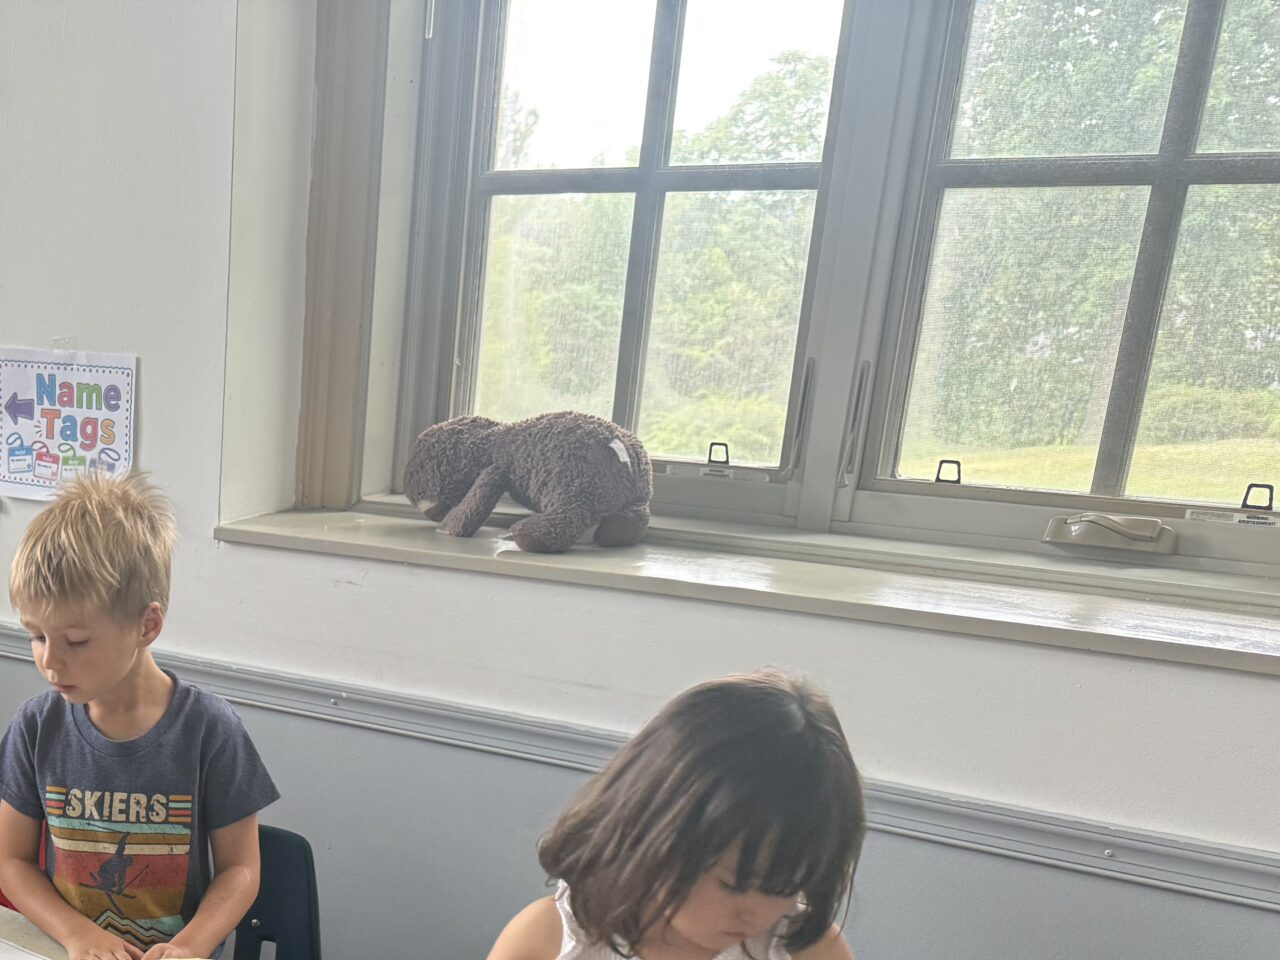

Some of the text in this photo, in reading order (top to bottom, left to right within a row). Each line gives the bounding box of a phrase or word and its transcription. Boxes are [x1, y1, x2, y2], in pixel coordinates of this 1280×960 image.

[36, 373, 122, 412] Name
[40, 408, 116, 452] Tags
[65, 788, 168, 823] SKIERS
